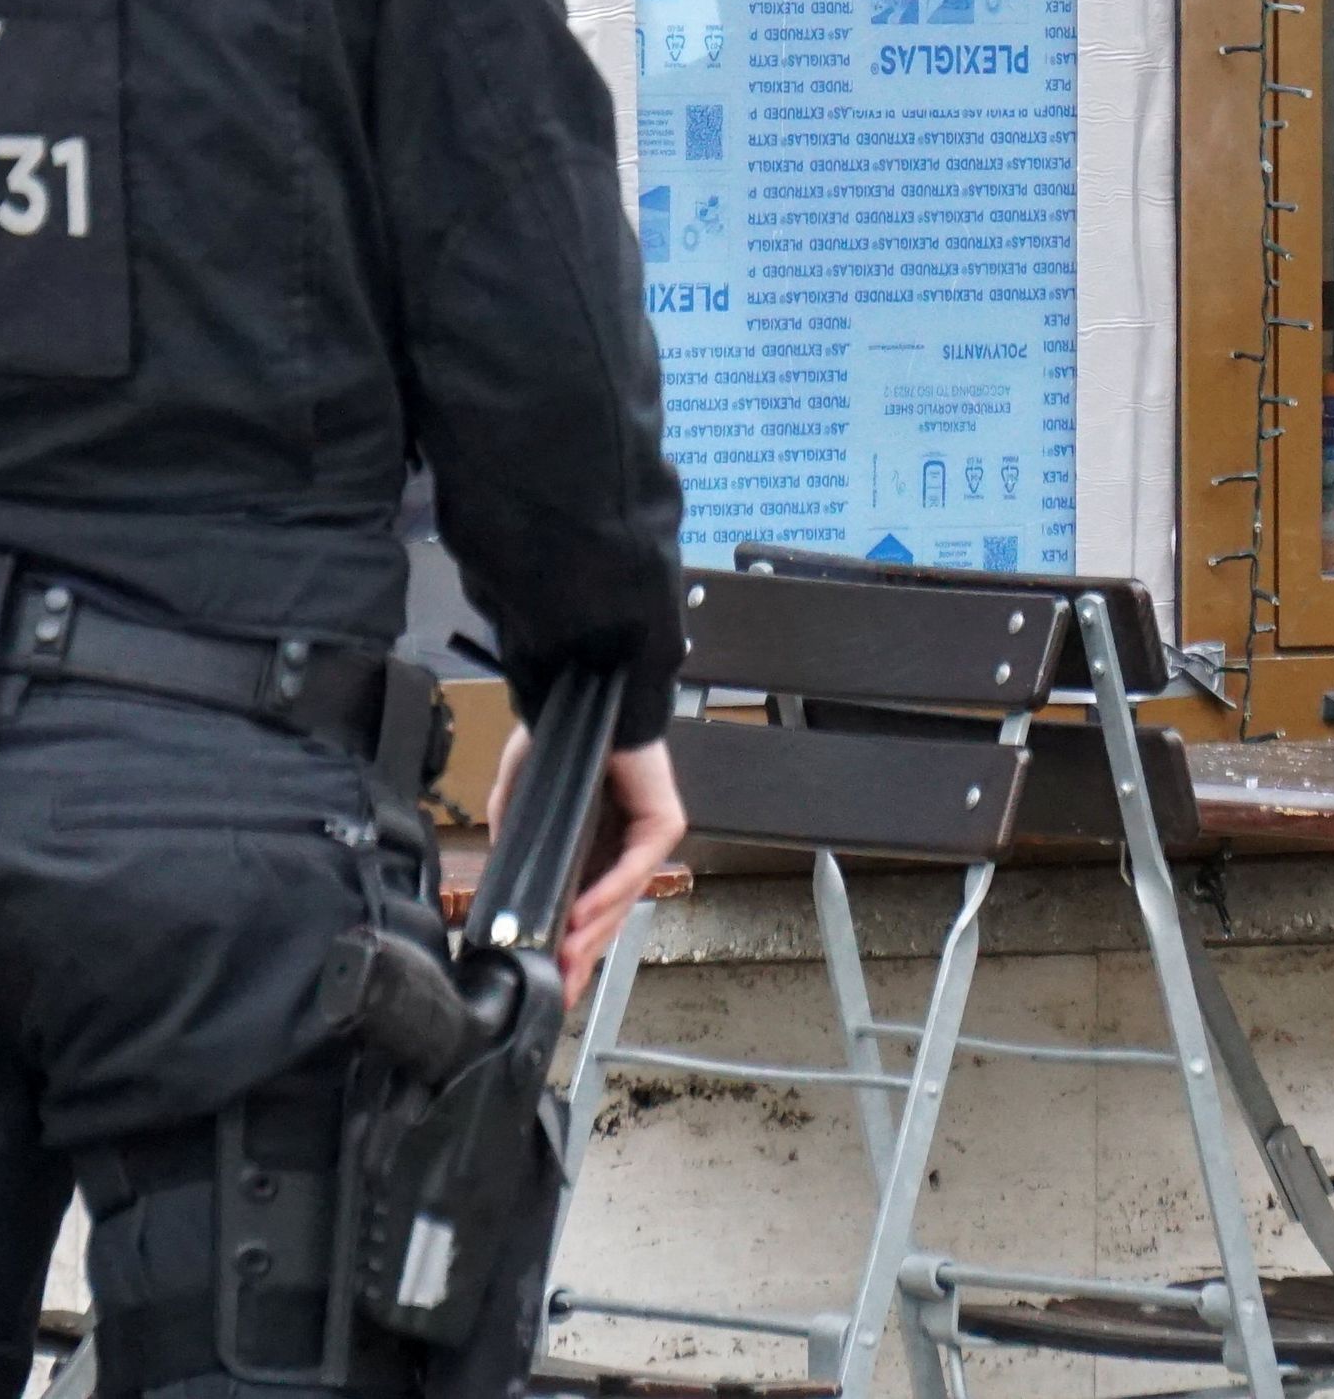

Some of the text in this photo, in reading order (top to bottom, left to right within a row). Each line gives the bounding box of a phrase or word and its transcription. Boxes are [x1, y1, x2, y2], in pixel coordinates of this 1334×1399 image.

[764, 29, 826, 41] EXTRUDED
[764, 107, 824, 120] EXTRUDED
[856, 133, 915, 145] EXTRUDED
[990, 132, 1047, 144] EXTRUDED
[810, 160, 869, 172] EXTRUDED
[946, 158, 1003, 170] EXTRUDED
[763, 186, 824, 199] EXTRUDED
[901, 185, 959, 197] EXTRUDED
[856, 212, 914, 224] EXTRUDED
[990, 210, 1046, 222] EXTRUDED
[810, 239, 869, 251] EXTRUDED
[945, 237, 1003, 249] EXTRUDED
[762, 266, 823, 277] EXTRUDED
[901, 264, 959, 276] EXTRUDED
[855, 290, 913, 303] EXTRUDED
[989, 289, 1046, 301] EXTRUDED
[762, 344, 822, 356] EXTRUDED
[943, 343, 1027, 359] POLYVANTIS
[714, 372, 776, 384] EXTRUDED
[667, 399, 728, 411] EXTRUDED
[883, 403, 1011, 415] EXTRUDED ACRYLIC SHEET
[761, 423, 821, 436] EXTRUDED
[714, 451, 774, 463] EXTRUDED
[760, 502, 820, 515] EXTRUDED
[713, 530, 773, 542] EXTRUDED
